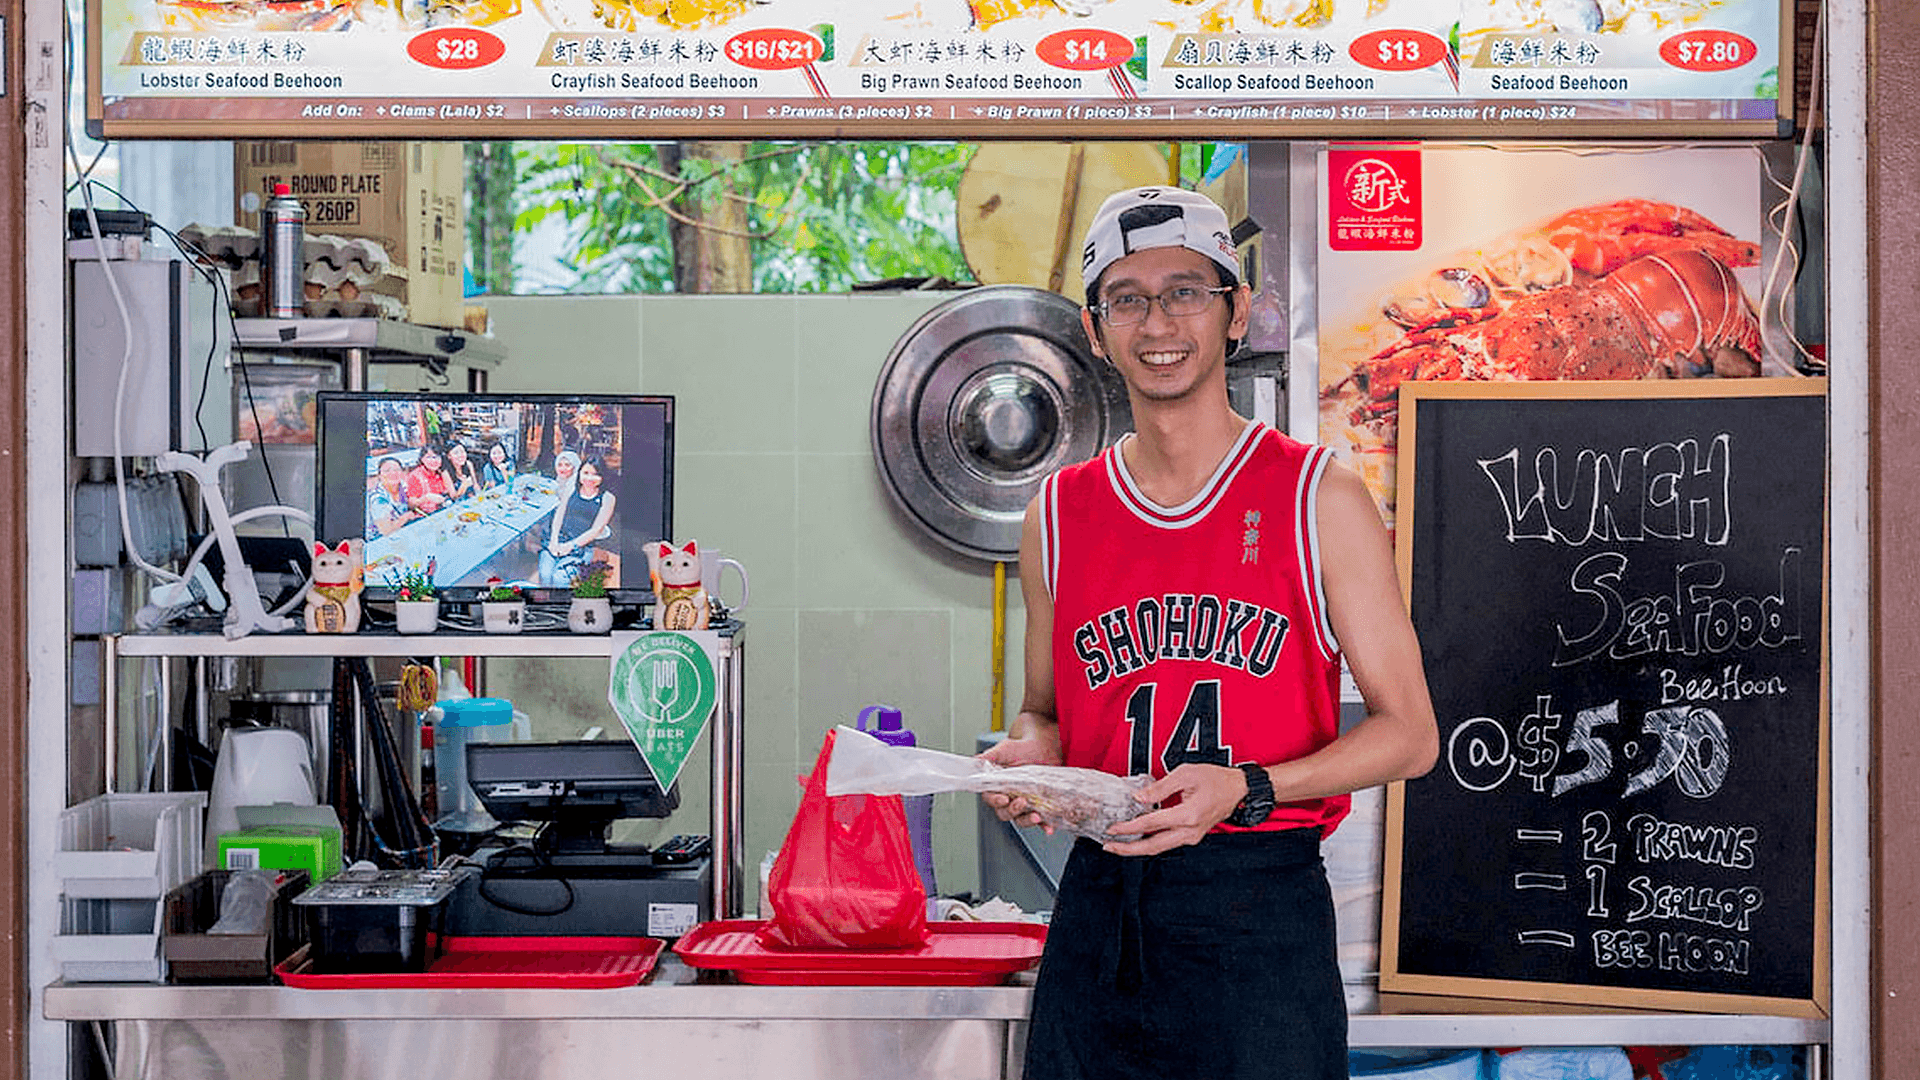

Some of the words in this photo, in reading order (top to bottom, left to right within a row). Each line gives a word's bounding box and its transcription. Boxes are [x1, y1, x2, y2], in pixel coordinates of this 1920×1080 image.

[436, 38, 478, 62] $28
[730, 39, 814, 63] $16/$21
[1065, 40, 1107, 63] $14
[1378, 40, 1420, 63] $13
[1678, 41, 1740, 63] $7.80
[140, 73, 200, 88] Lobster
[205, 73, 268, 88] Seafood
[274, 73, 342, 88] Beehoon
[551, 73, 616, 92] Crayfish
[621, 73, 684, 89] Seafood
[690, 73, 758, 89] Beehoon
[862, 74, 888, 93] Big
[892, 74, 940, 89] Prawn
[945, 74, 1008, 89] Seafood
[1013, 74, 1082, 90] Beehoon
[1174, 74, 1233, 93] Scallop
[1237, 74, 1300, 90] Seafood
[1305, 74, 1374, 90] Beehoon
[1491, 74, 1555, 90] Seafood
[1560, 74, 1628, 90] Beehoon
[302, 104, 333, 117] Add
[336, 104, 363, 117] On:
[390, 104, 435, 117] Clams
[439, 104, 482, 119] (Lala)
[486, 104, 504, 118] $2
[563, 104, 627, 119] Scallops
[631, 105, 648, 119] (2
[707, 105, 726, 118] $3
[780, 105, 834, 118] Prawns
[838, 105, 855, 119] (3
[914, 105, 933, 119] $2
[988, 105, 1013, 120] Big
[1017, 105, 1062, 118] Prawn
[1066, 106, 1080, 120] (1
[1134, 106, 1151, 119] $3
[1207, 105, 1268, 120] Crayfish
[1272, 106, 1289, 120] (1
[1340, 106, 1366, 119] $10
[1422, 106, 1479, 119] Lobster
[1482, 106, 1497, 120] (1
[1549, 106, 1576, 119] $24
[292, 174, 337, 194] ROUND
[341, 174, 380, 194] PLATE
[1351, 166, 1411, 209] 新式
[316, 201, 354, 221] 260P
[1476, 431, 1731, 546] LUNCH
[1074, 594, 1290, 690] SHOHOKU
[646, 728, 685, 739] UBER
[1125, 679, 1233, 777] 14
[1582, 810, 1618, 865] 2
[1626, 813, 1758, 870] PRAWNS
[1586, 864, 1610, 918] 1
[1593, 929, 1653, 969] BEE
[1658, 931, 1750, 976] HOON
